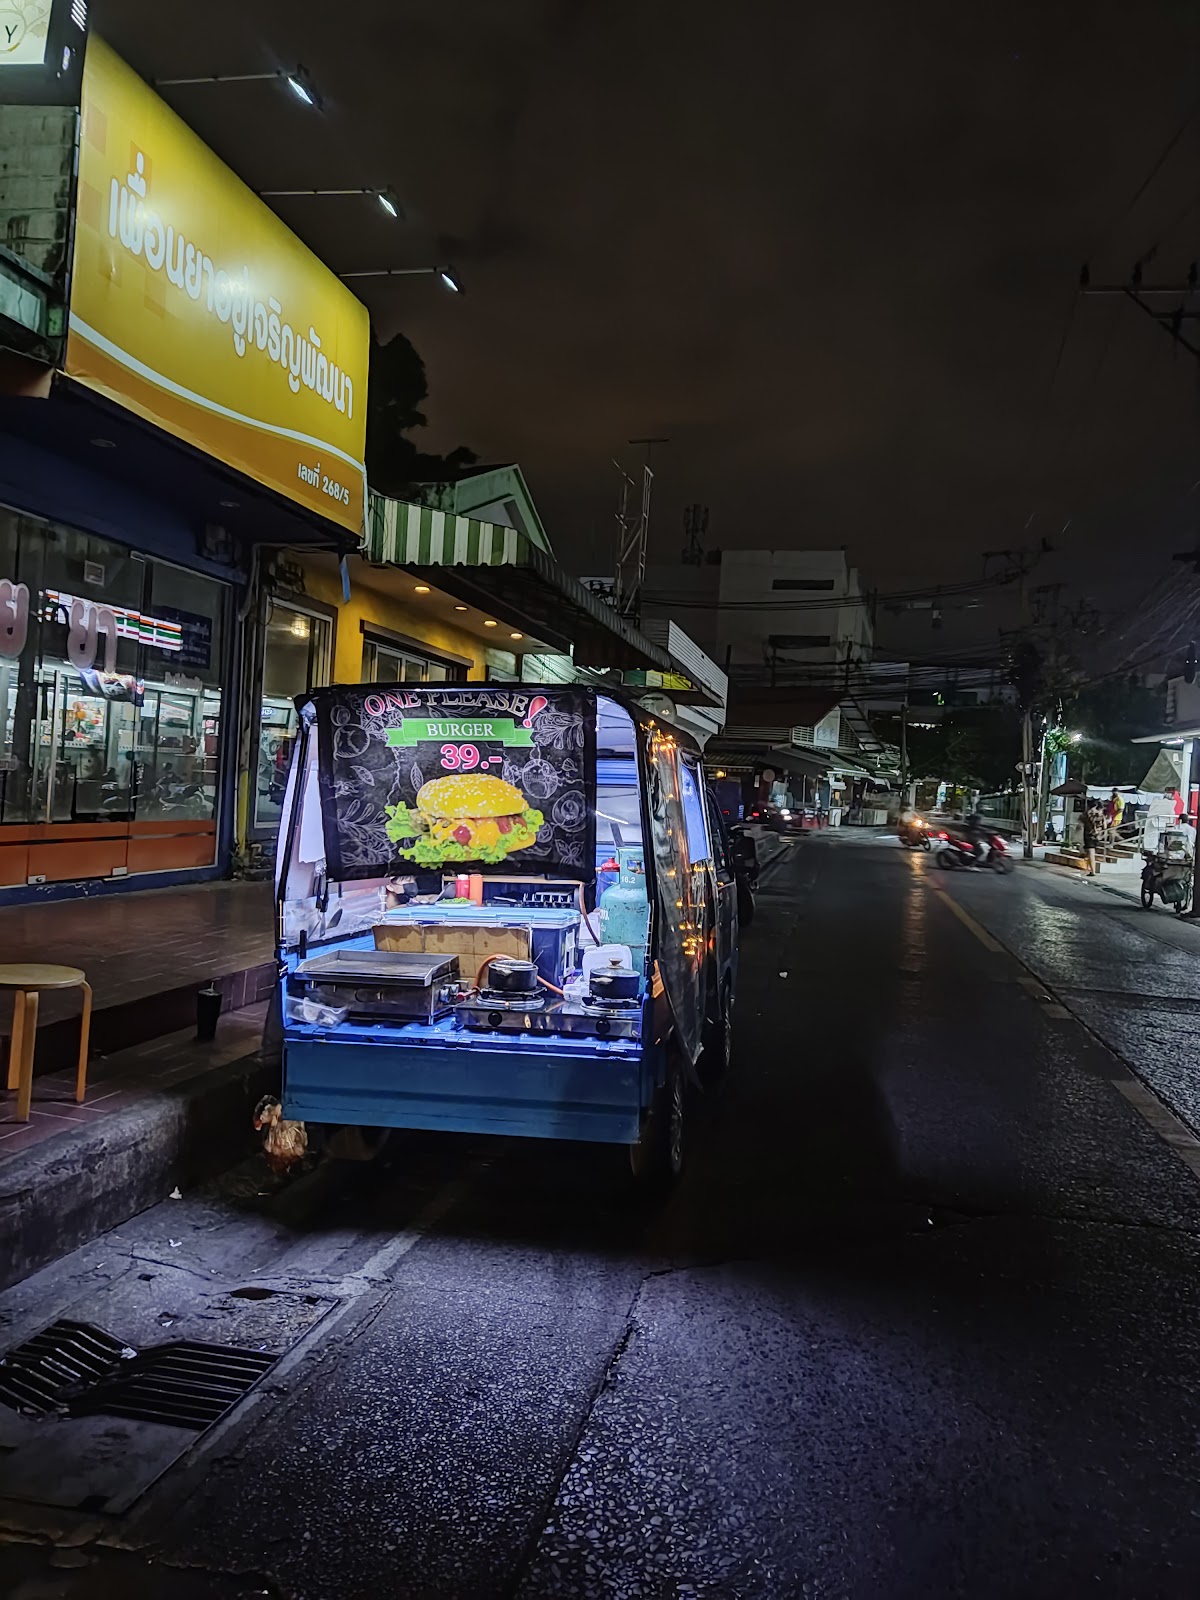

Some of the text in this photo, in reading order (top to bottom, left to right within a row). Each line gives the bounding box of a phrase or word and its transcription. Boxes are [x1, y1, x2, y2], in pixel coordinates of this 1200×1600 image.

[297, 462, 349, 505] เลขที่ 268/5
[364, 691, 421, 716] ONE
[426, 723, 496, 737] BURGER
